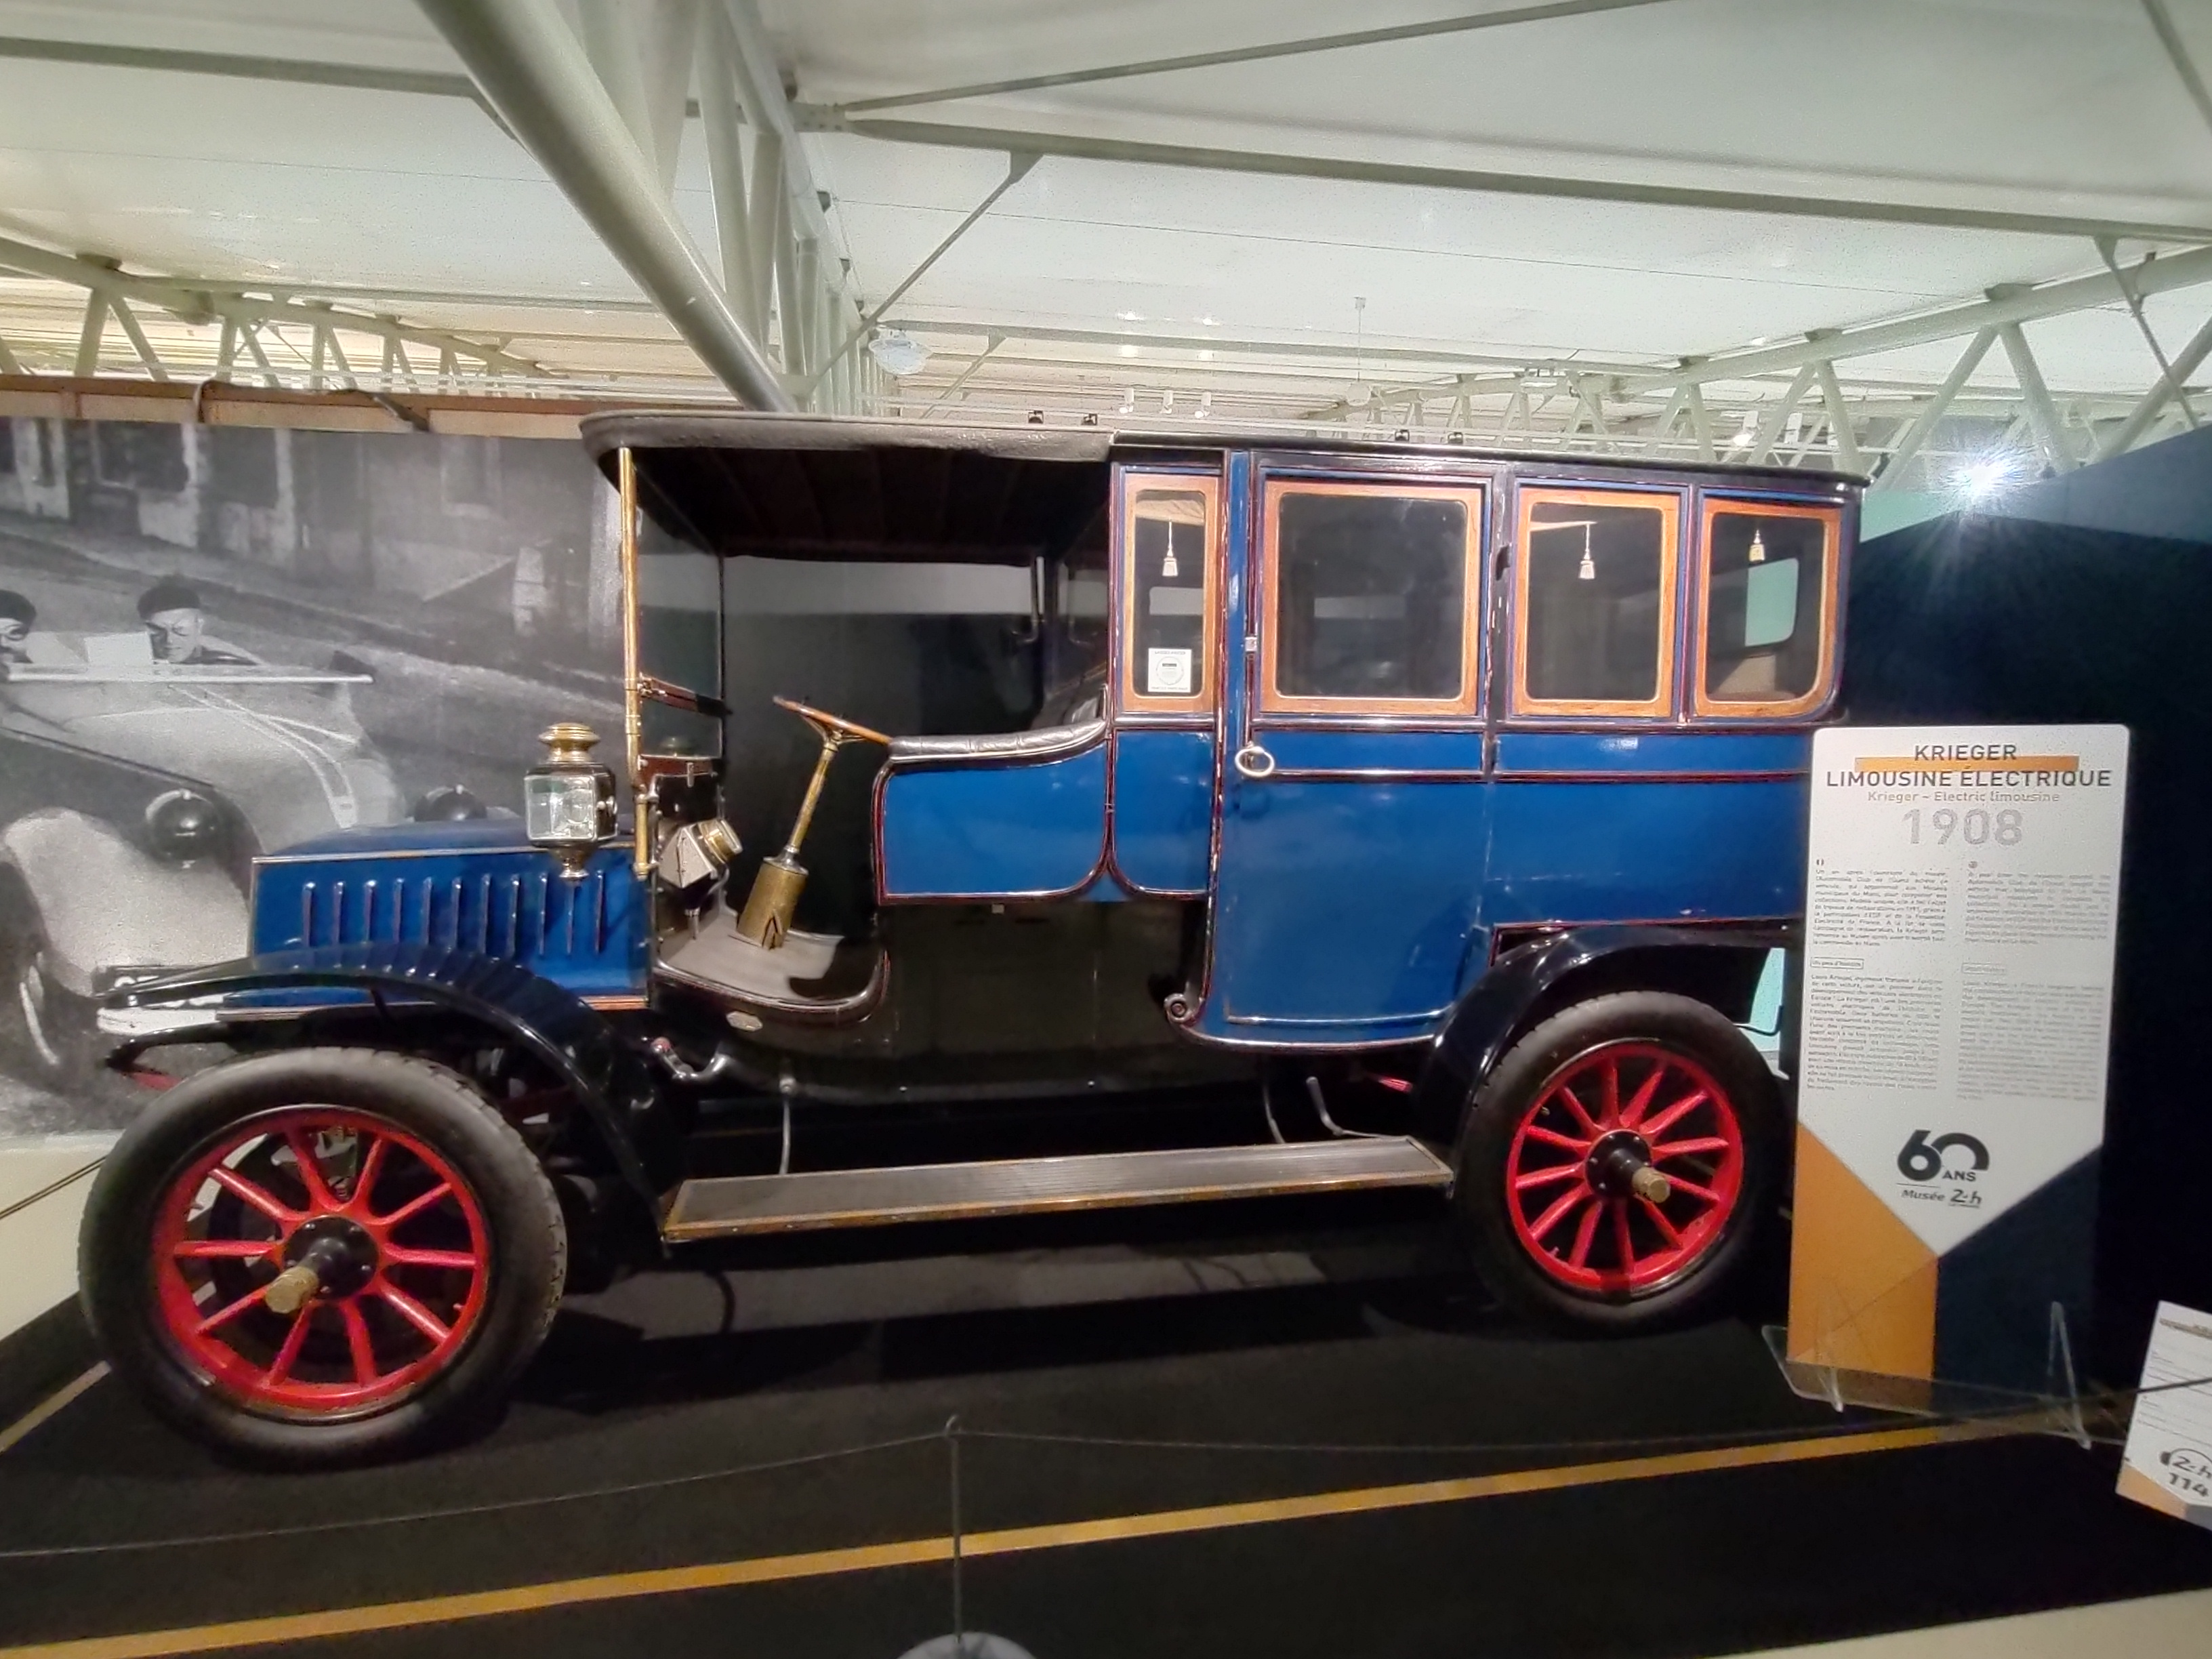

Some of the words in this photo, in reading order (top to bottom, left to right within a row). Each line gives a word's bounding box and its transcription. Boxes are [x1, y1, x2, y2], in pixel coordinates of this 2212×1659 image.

[1914, 744, 2018, 761] KRIEGER
[1826, 771, 1952, 787] LIMOUSINE
[1868, 791, 1919, 803] Krieger
[1934, 791, 1986, 802] Electric
[1990, 791, 2060, 802] limousine
[1901, 807, 2024, 846] 1908
[1897, 1129, 1990, 1182] 60
[1942, 1170, 1976, 1182] ANS
[1900, 1189, 1946, 1202] Musée
[2169, 1472, 2209, 1498] 114
